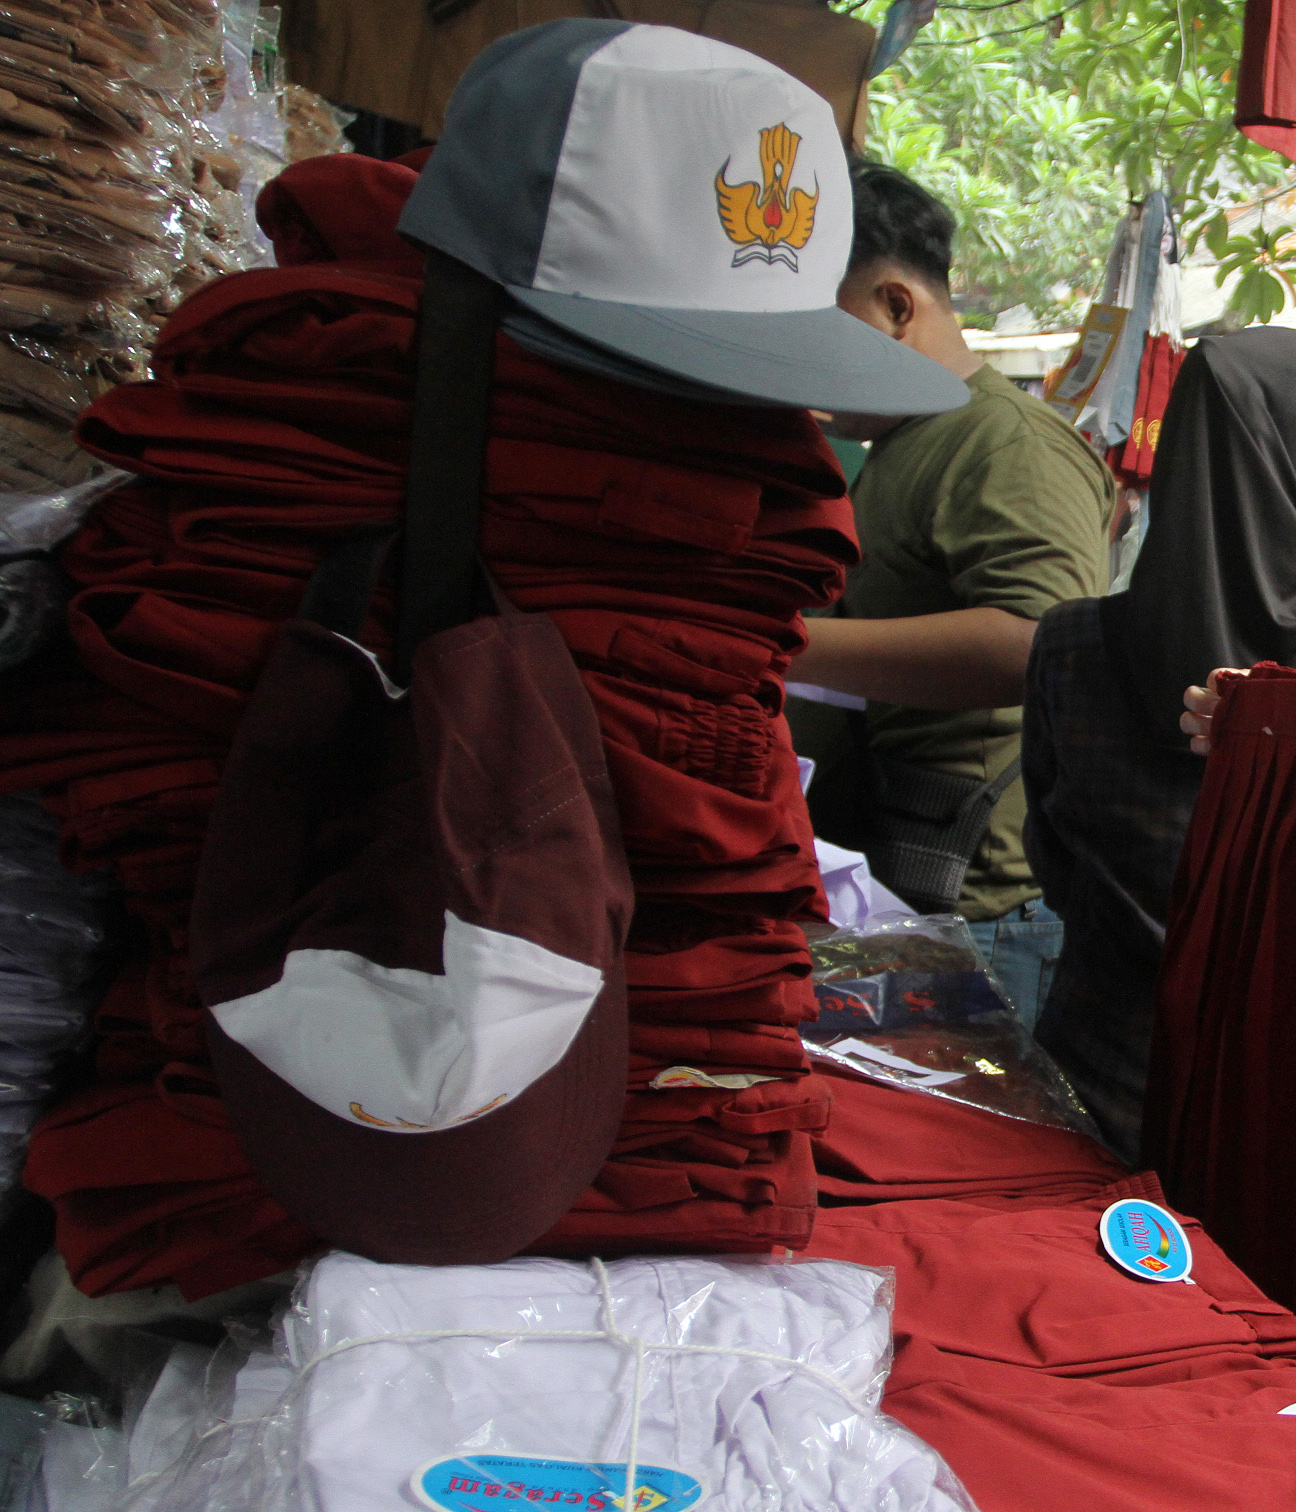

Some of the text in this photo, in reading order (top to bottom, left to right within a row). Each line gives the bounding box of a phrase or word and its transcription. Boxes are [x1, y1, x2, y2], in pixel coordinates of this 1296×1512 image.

[1127, 1212, 1152, 1253] AFIQAH
[477, 1460, 527, 1468] TERATAS
[448, 1476, 606, 1512] Seragam
